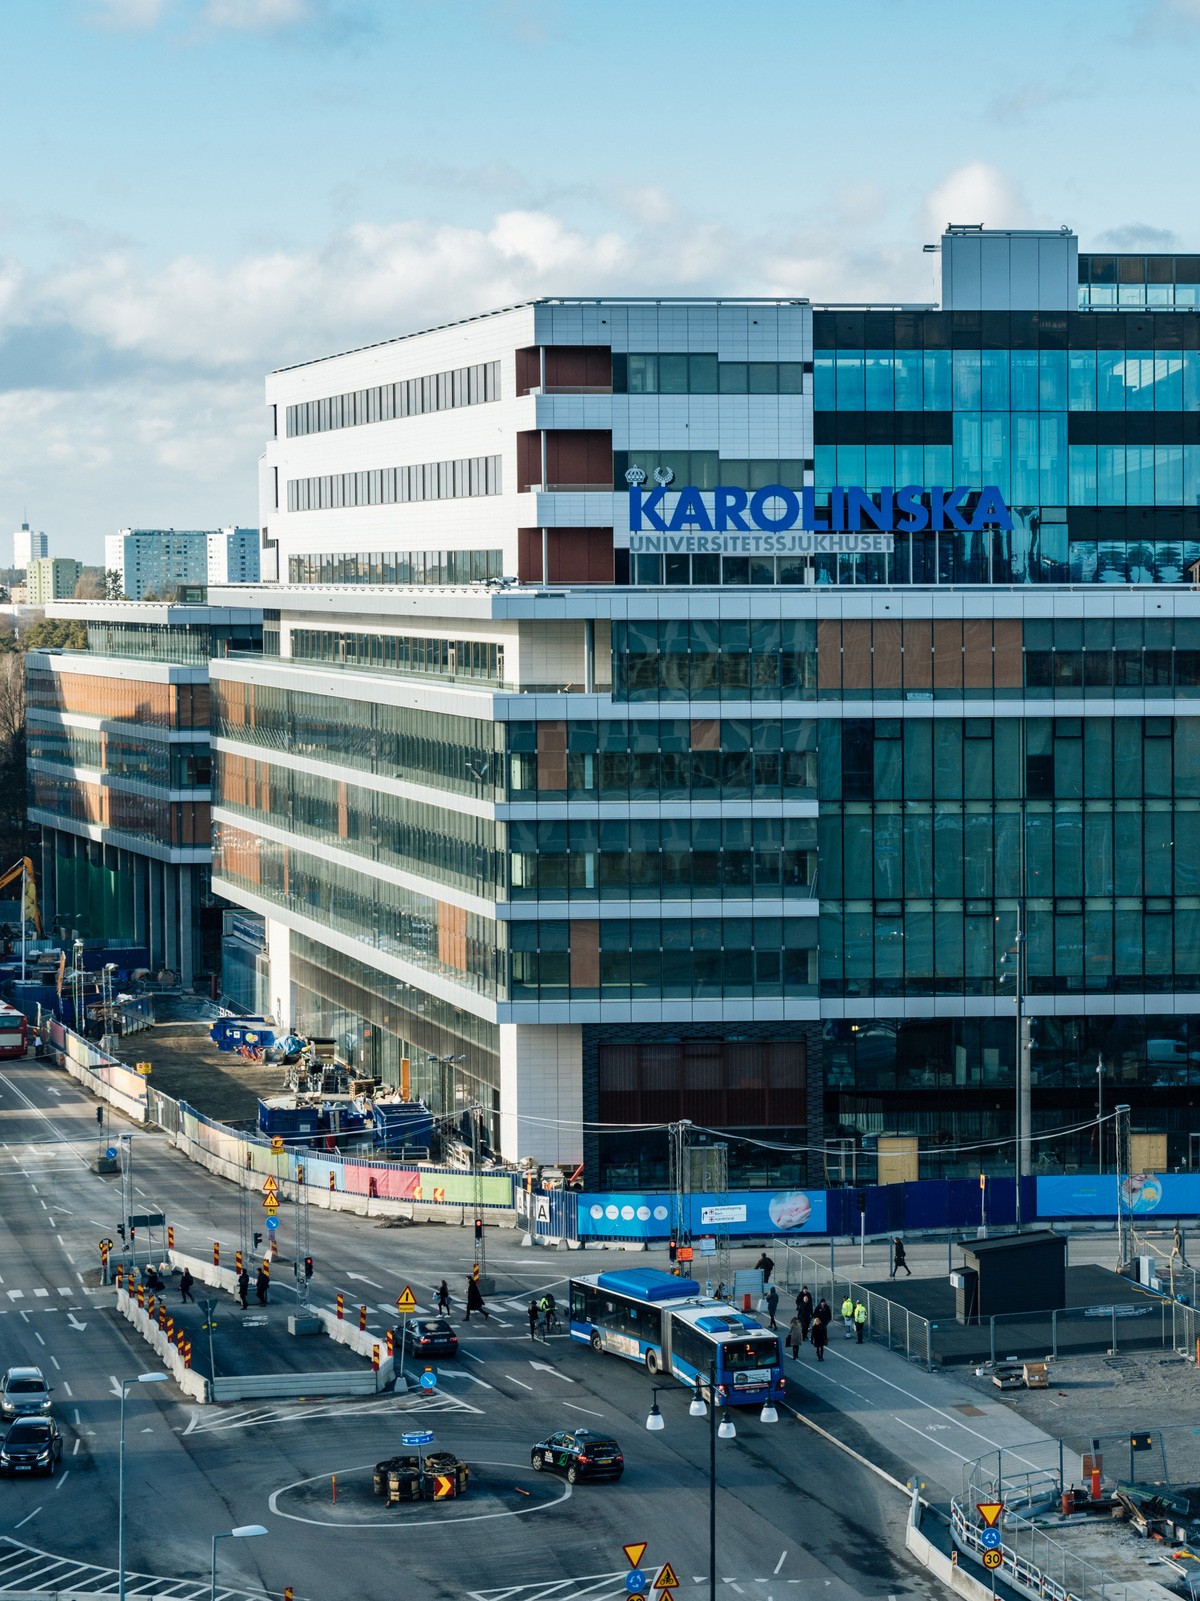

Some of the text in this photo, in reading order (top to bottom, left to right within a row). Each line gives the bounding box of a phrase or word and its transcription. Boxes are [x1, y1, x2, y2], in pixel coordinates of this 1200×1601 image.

[629, 484, 1014, 532] KAROLINSKA
[630, 534, 894, 552] UNIVERSITETSSJUKHUSET
[537, 1205, 547, 1220] A
[986, 1554, 1000, 1565] 30
